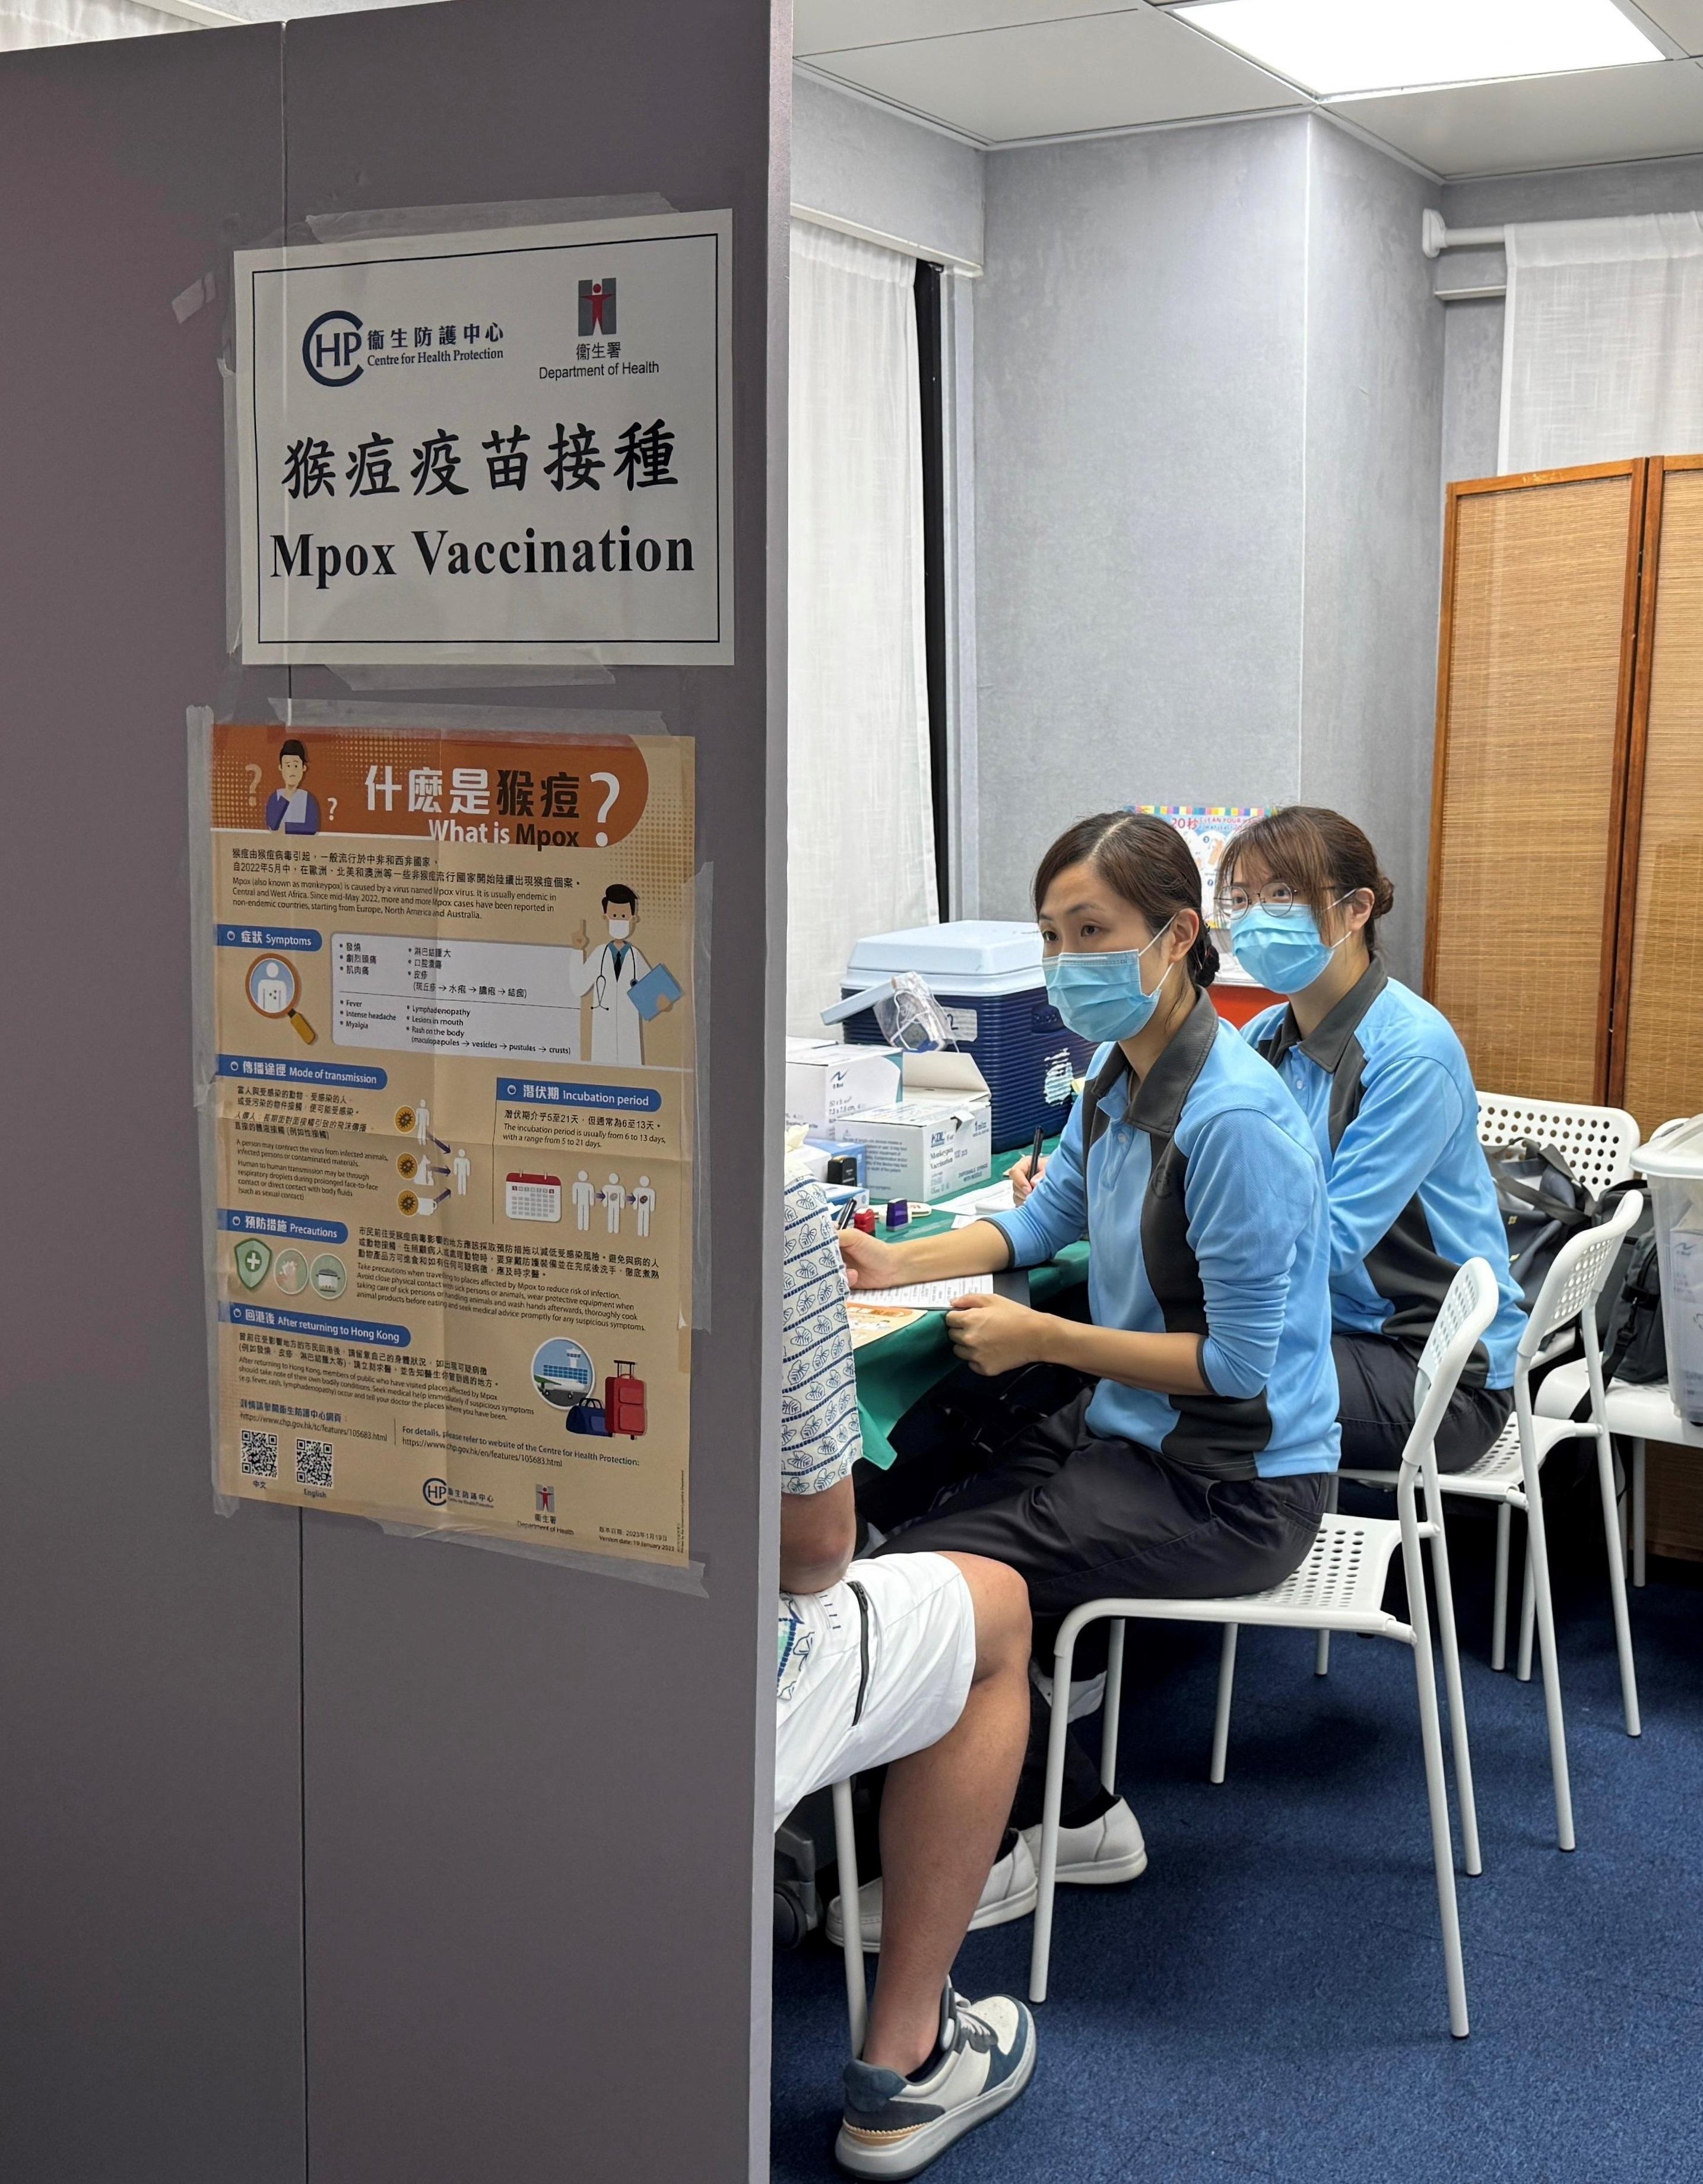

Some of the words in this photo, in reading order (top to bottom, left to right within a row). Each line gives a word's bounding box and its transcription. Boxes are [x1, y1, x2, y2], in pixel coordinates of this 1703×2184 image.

[367, 355, 399, 367] Centre
[401, 353, 415, 364] for
[417, 350, 450, 363] Health
[453, 347, 503, 361] Protection
[539, 365, 604, 380] Department
[608, 363, 619, 375] of
[622, 361, 659, 374] Health
[282, 418, 678, 499] 猴痘疫苗接種
[270, 533, 397, 589] Mpox
[411, 525, 694, 574] Vaccination
[429, 818, 488, 842] What
[493, 821, 510, 845] is
[516, 824, 579, 851] Mpox
[233, 878, 250, 886] Mpox
[252, 878, 267, 887] (also
[301, 882, 342, 891] monkeypox)
[376, 885, 385, 894] by
[490, 891, 515, 900] usually
[328, 894, 359, 903] mid-May
[361, 895, 380, 903] 2022,
[277, 902, 310, 910] countries,
[311, 904, 337, 912] starting
[356, 905, 382, 915] Europe,
[446, 910, 481, 919] Australia.
[241, 931, 262, 944] 症狀
[266, 934, 311, 947] Symptoms
[412, 1006, 470, 1018] Lymphadenopathy
[345, 1021, 368, 1030] Myalgia
[446, 1028, 464, 1039] body
[290, 1068, 313, 1078] Mode
[315, 1070, 324, 1080] of
[325, 1072, 376, 1084] transmission
[563, 1090, 614, 1103] Incubation
[617, 1096, 649, 1106] period
[516, 1125, 552, 1134] incubation
[583, 1131, 605, 1139] usually
[290, 1225, 337, 1237] Precautions
[278, 1317, 298, 1328] After
[299, 1322, 338, 1335] returning
[340, 1326, 349, 1335] to
[350, 1326, 374, 1340] Hong
[376, 1330, 399, 1344] Kong
[414, 1429, 440, 1439] details,
[487, 1440, 515, 1449] website
[538, 1446, 561, 1455] Centre
[575, 1451, 597, 1460] Health
[600, 1455, 639, 1466] Protection:
[253, 1480, 266, 1489] 中文
[303, 1488, 326, 1499] English
